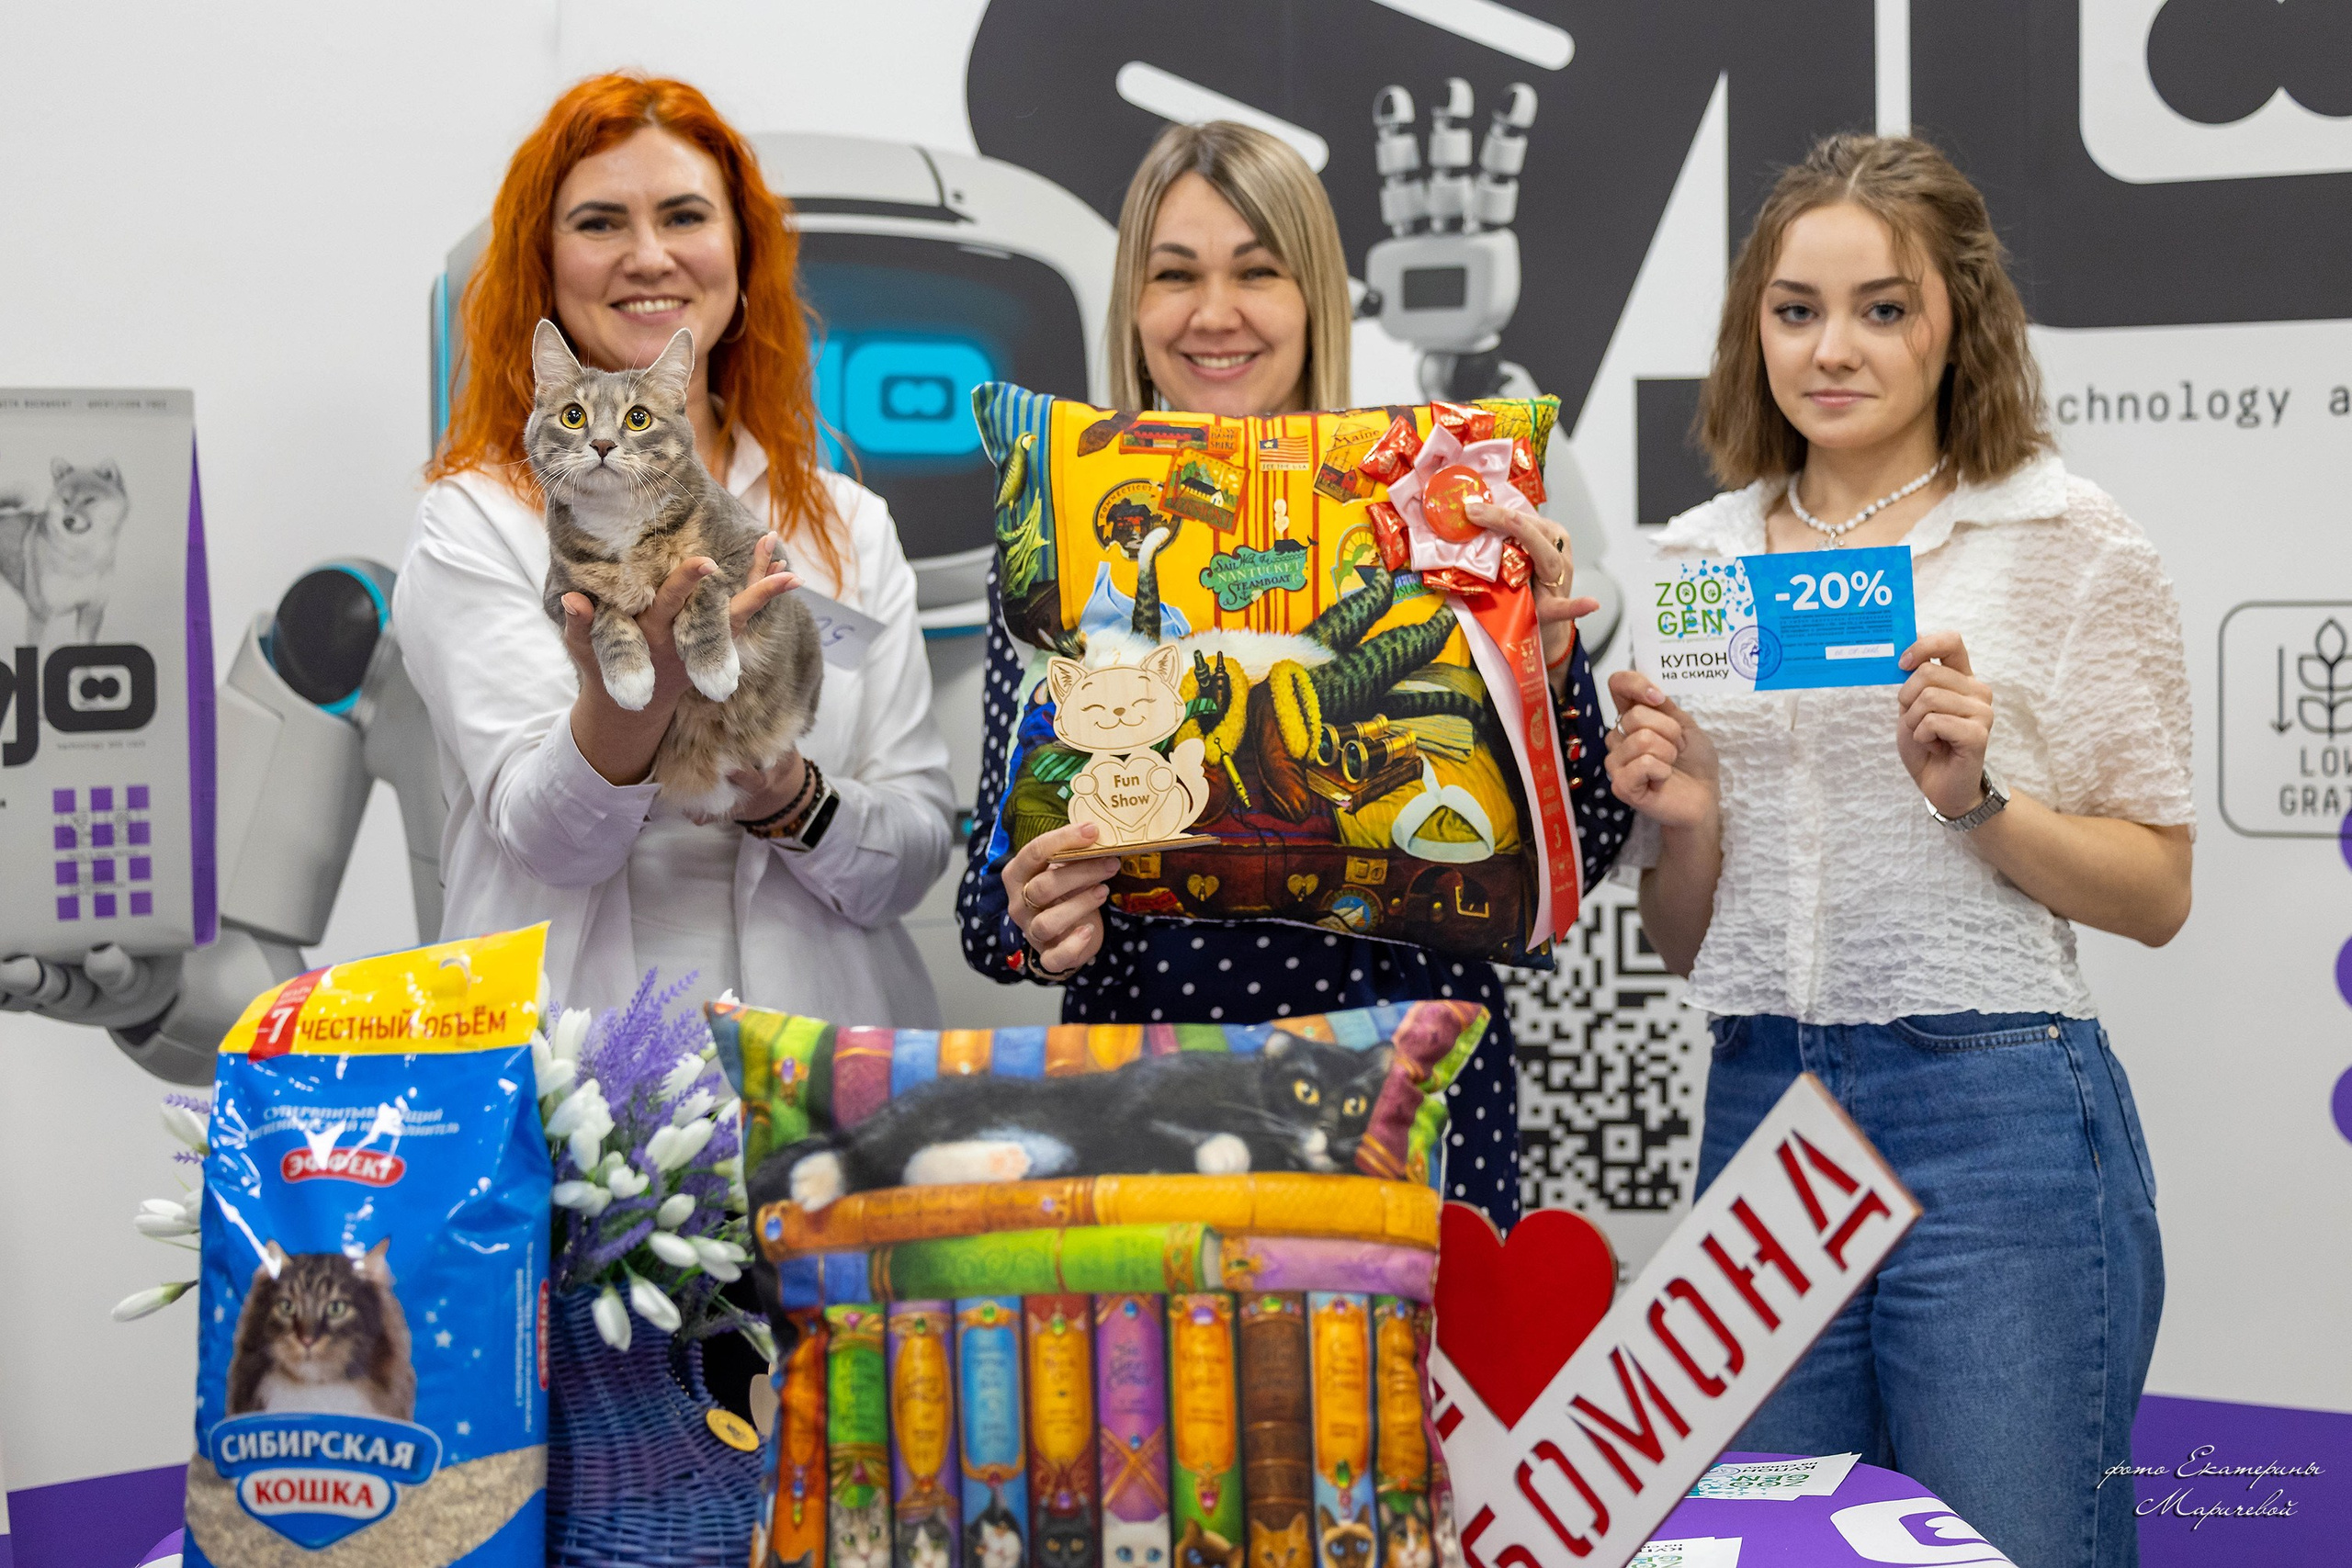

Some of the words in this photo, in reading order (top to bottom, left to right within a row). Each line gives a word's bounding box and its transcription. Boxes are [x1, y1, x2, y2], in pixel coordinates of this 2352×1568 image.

[2055, 379, 2291, 429] chnology
[1332, 429, 1380, 448] Maine
[1099, 483, 1154, 519] CONNECTICUT
[1217, 560, 1300, 584] NANTUCKET
[1223, 574, 1291, 605] STEAMBOAT
[1655, 580, 1723, 607] ZOO
[1774, 569, 1893, 611] -20%
[1657, 608, 1724, 636] GEN
[1660, 651, 1728, 668] КУПОН
[1662, 670, 1678, 680] на
[1681, 668, 1730, 681] скидку
[1114, 773, 1140, 788] Fun
[1110, 794, 1150, 808] Show
[301, 1009, 413, 1042] ЧЕСТНЫЙ
[424, 1005, 506, 1039] ОБЪЁМ
[288, 1153, 396, 1182] ЭФФЕКТ
[220, 1429, 416, 1471] СИБИРСКАЯ
[254, 1477, 376, 1509] КОШКА
